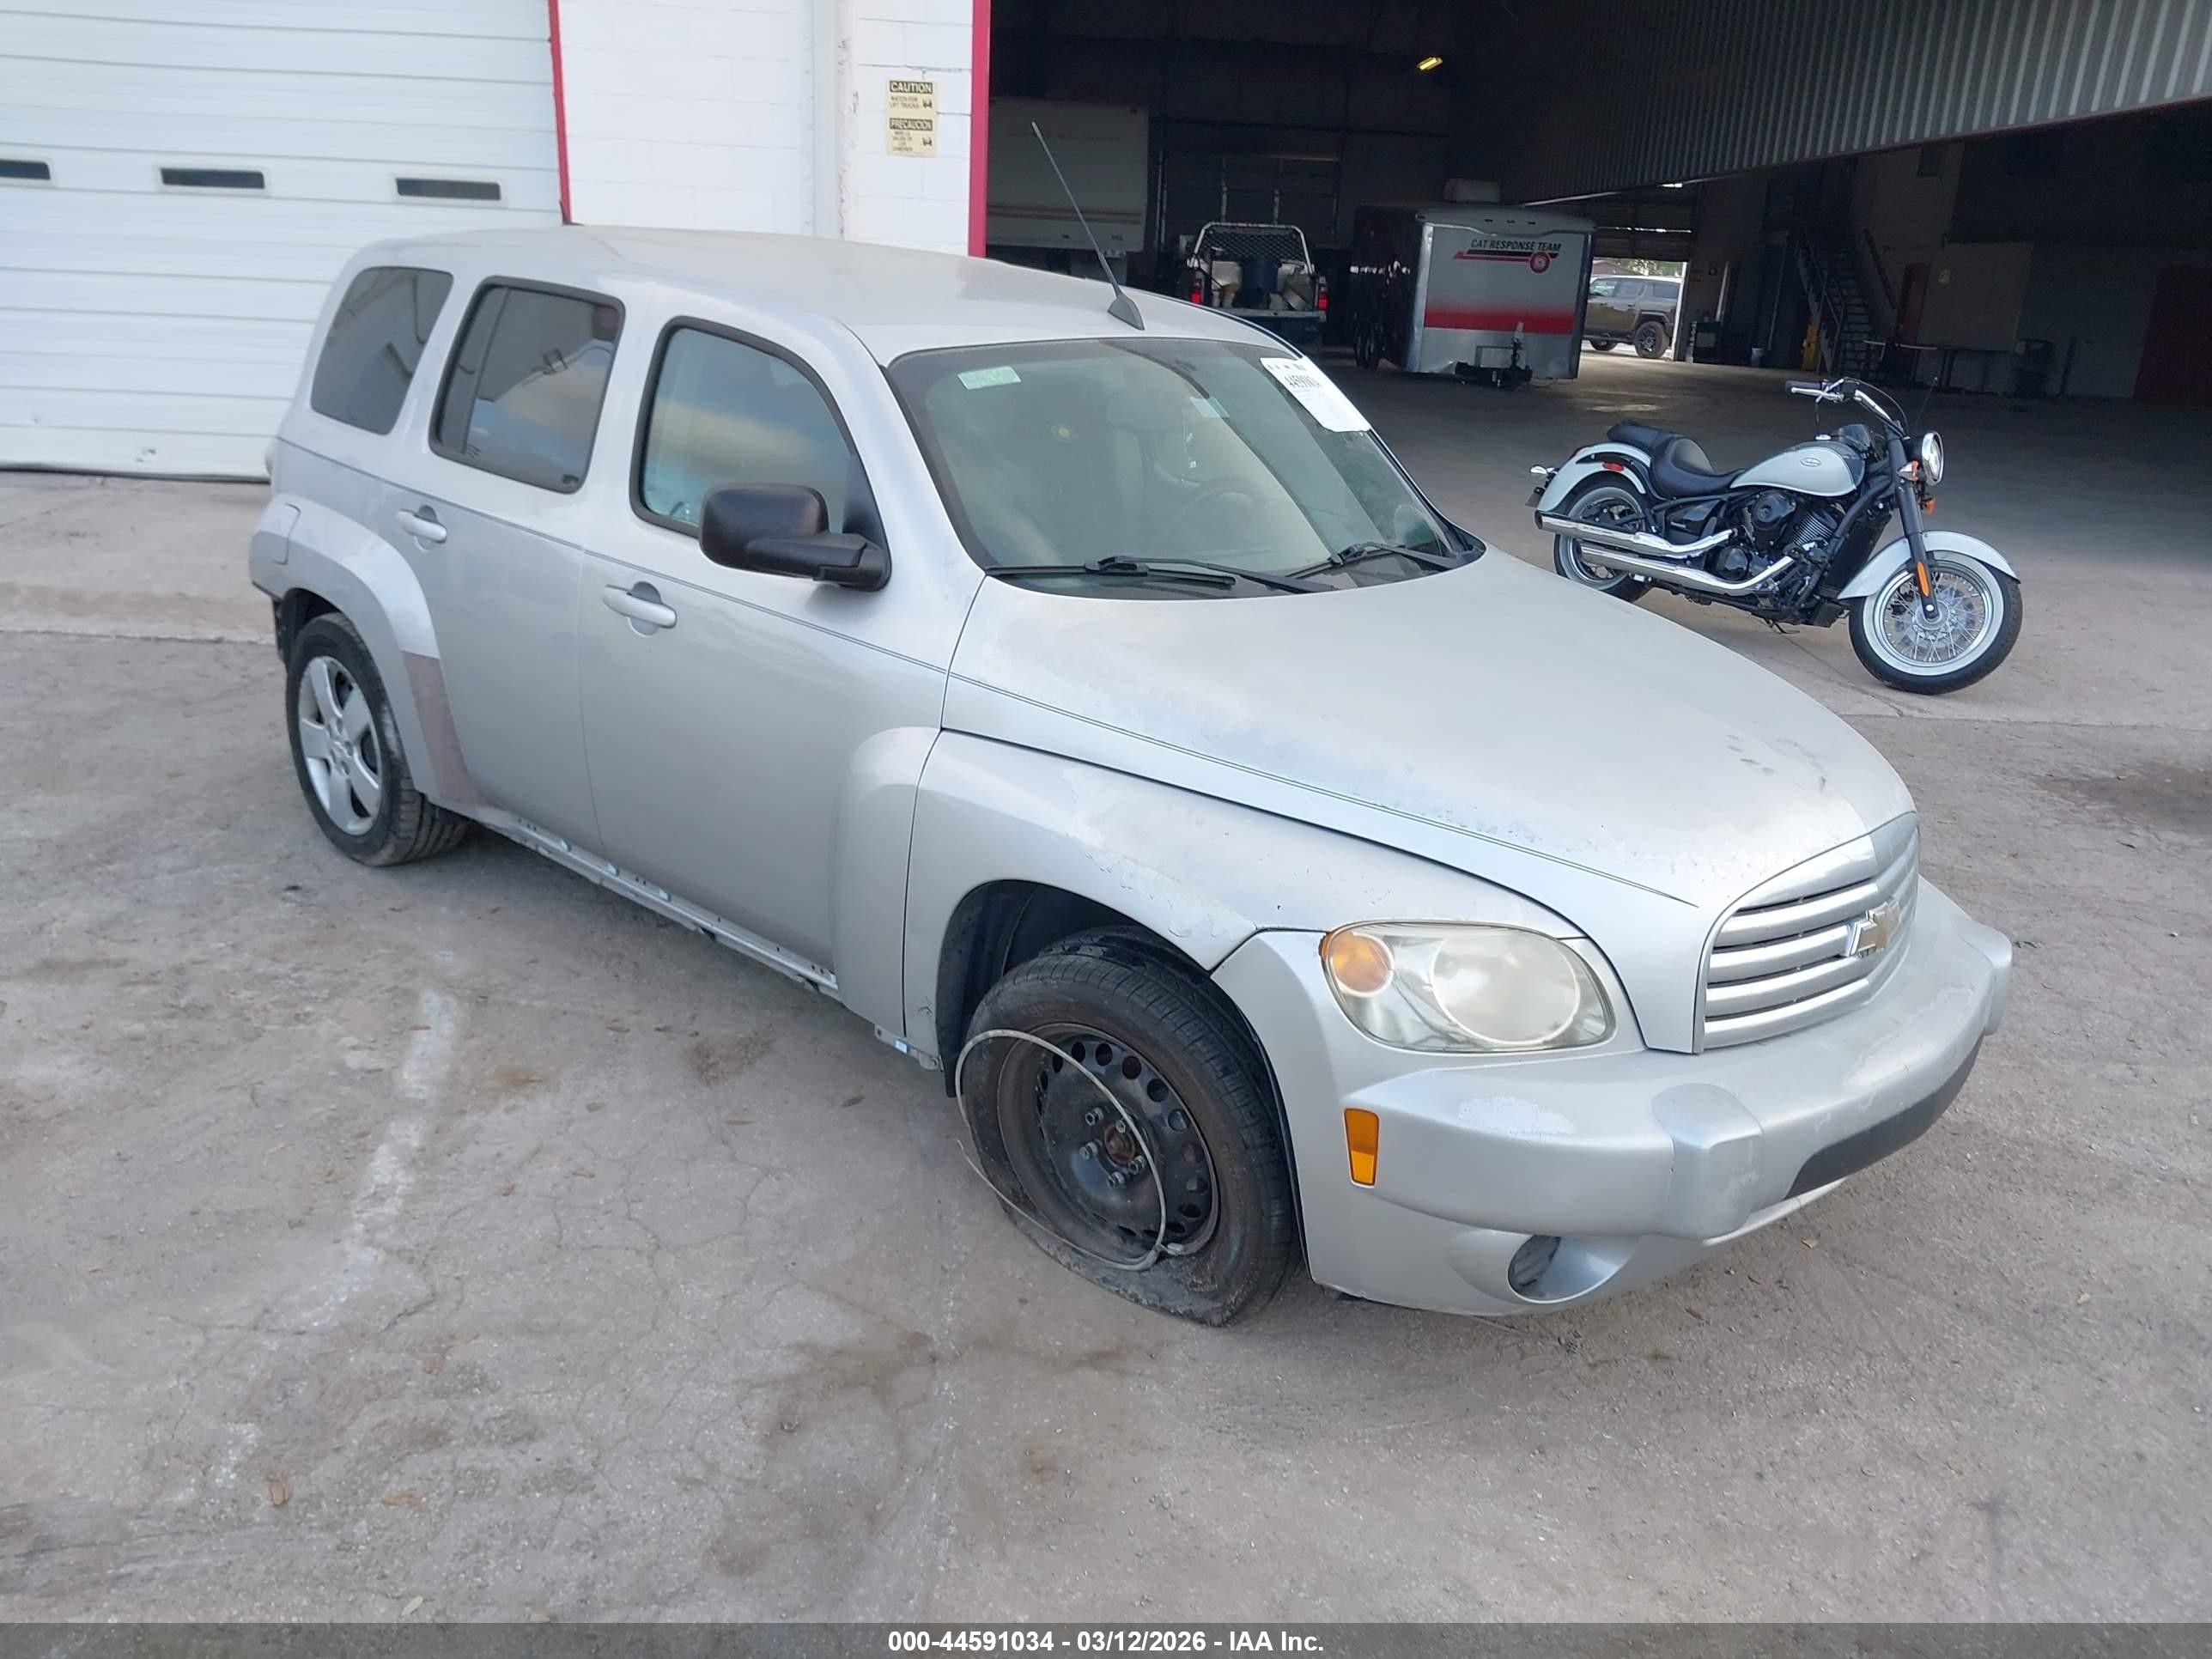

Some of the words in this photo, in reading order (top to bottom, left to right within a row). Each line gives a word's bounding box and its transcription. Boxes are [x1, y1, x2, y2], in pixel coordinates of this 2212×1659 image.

[890, 82, 932, 94] CAUTION
[1471, 239, 1487, 248] CAT
[1489, 240, 1536, 250] RESPONSE
[1537, 242, 1561, 252] TEAM
